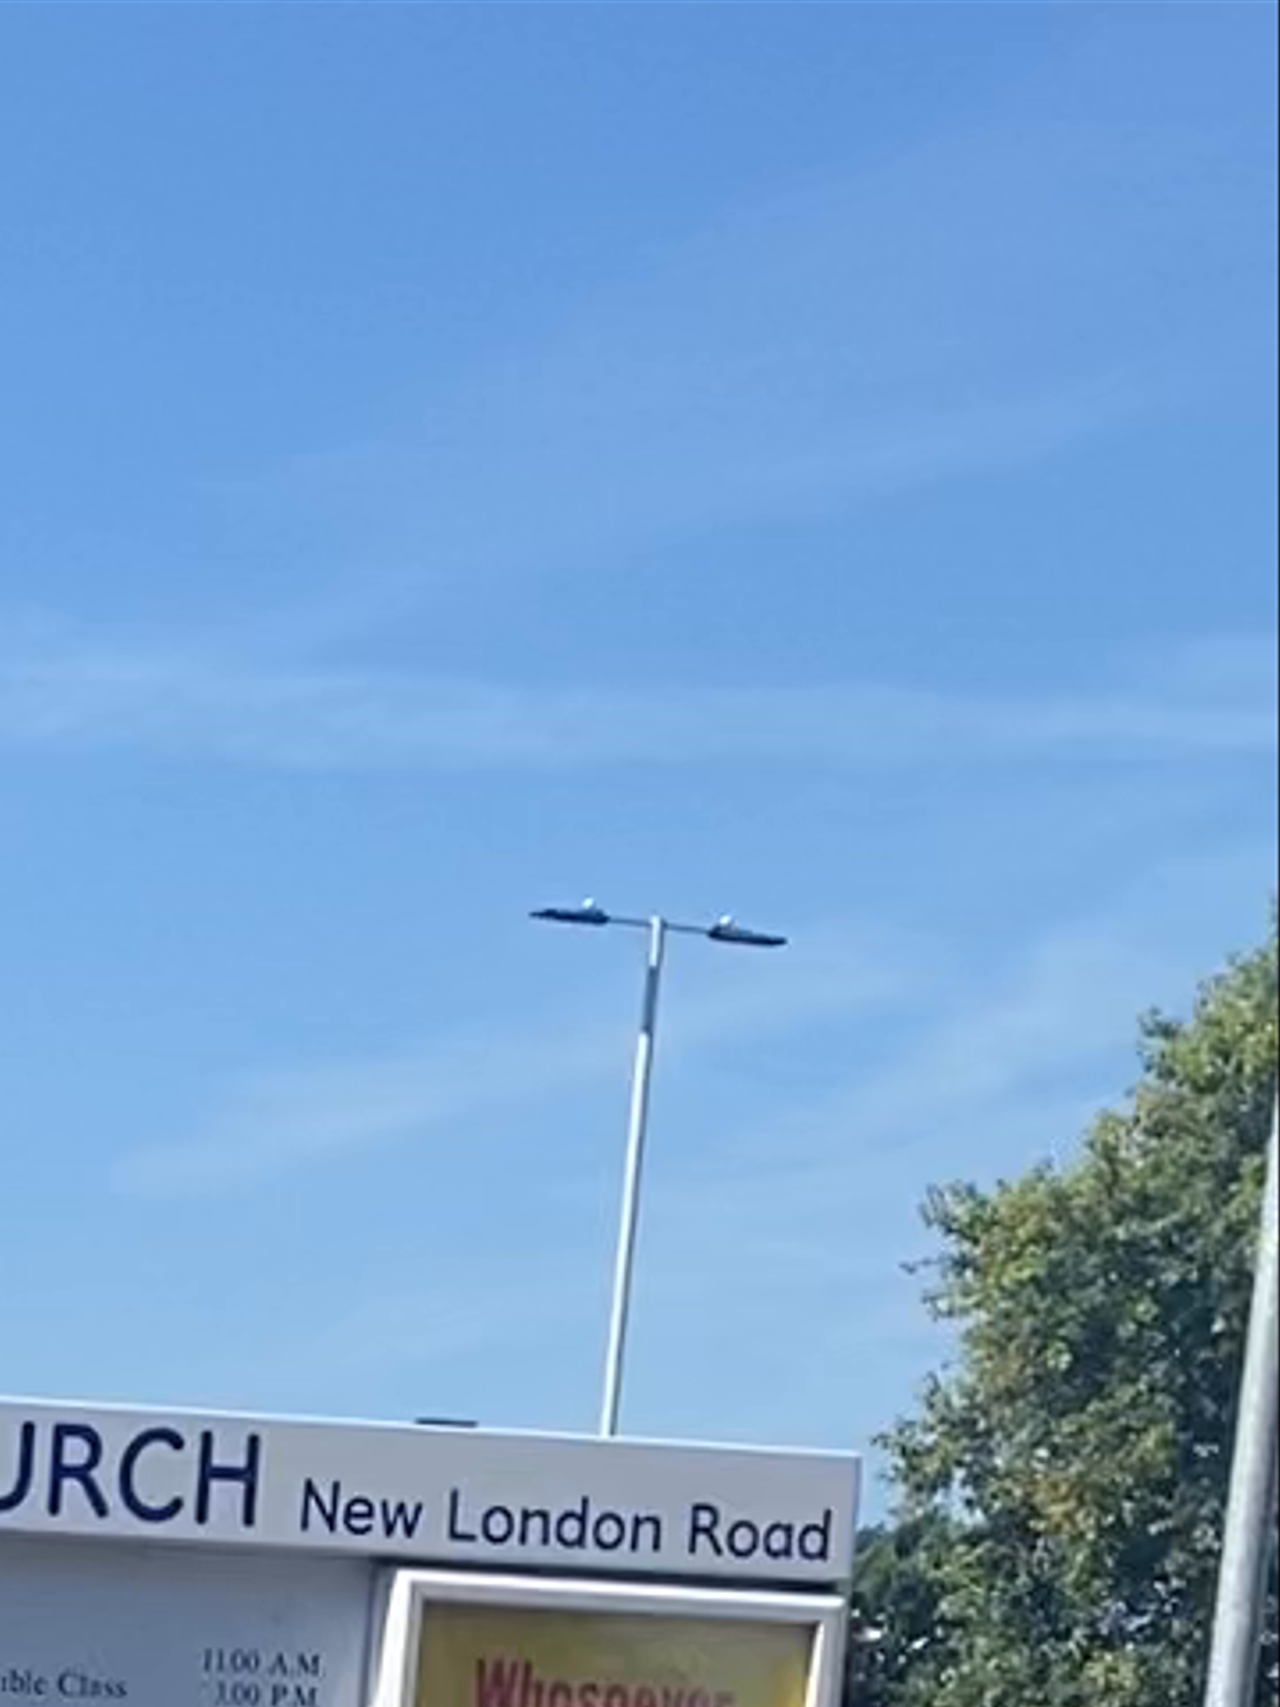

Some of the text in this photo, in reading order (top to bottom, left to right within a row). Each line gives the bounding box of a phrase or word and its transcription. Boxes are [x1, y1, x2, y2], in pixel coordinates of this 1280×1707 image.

[300, 1479, 423, 1538] New
[448, 1489, 662, 1552] London
[687, 1503, 832, 1561] Road
[57, 1672, 128, 1699] Class
